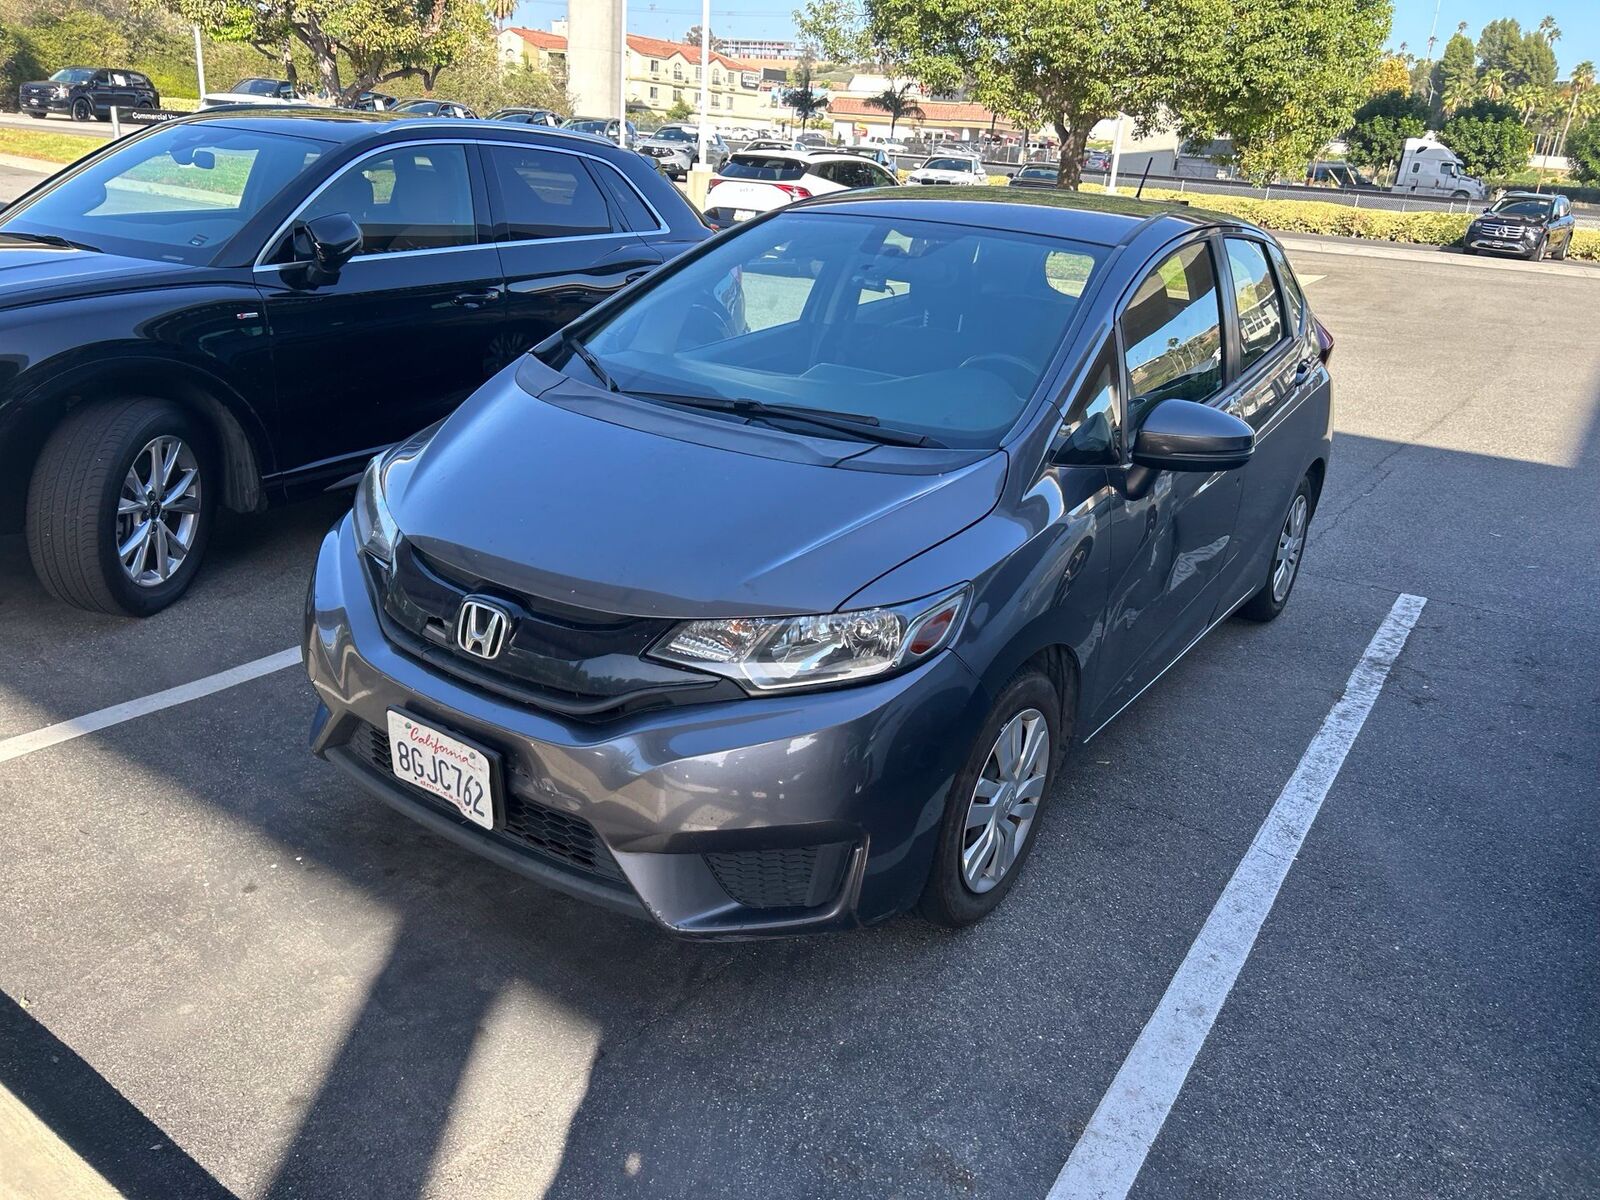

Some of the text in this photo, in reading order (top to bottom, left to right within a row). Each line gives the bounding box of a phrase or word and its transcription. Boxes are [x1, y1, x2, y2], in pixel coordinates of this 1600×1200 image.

[132, 111, 168, 121] Commercial
[410, 727, 475, 770] California
[397, 741, 485, 817] 8GJC762
